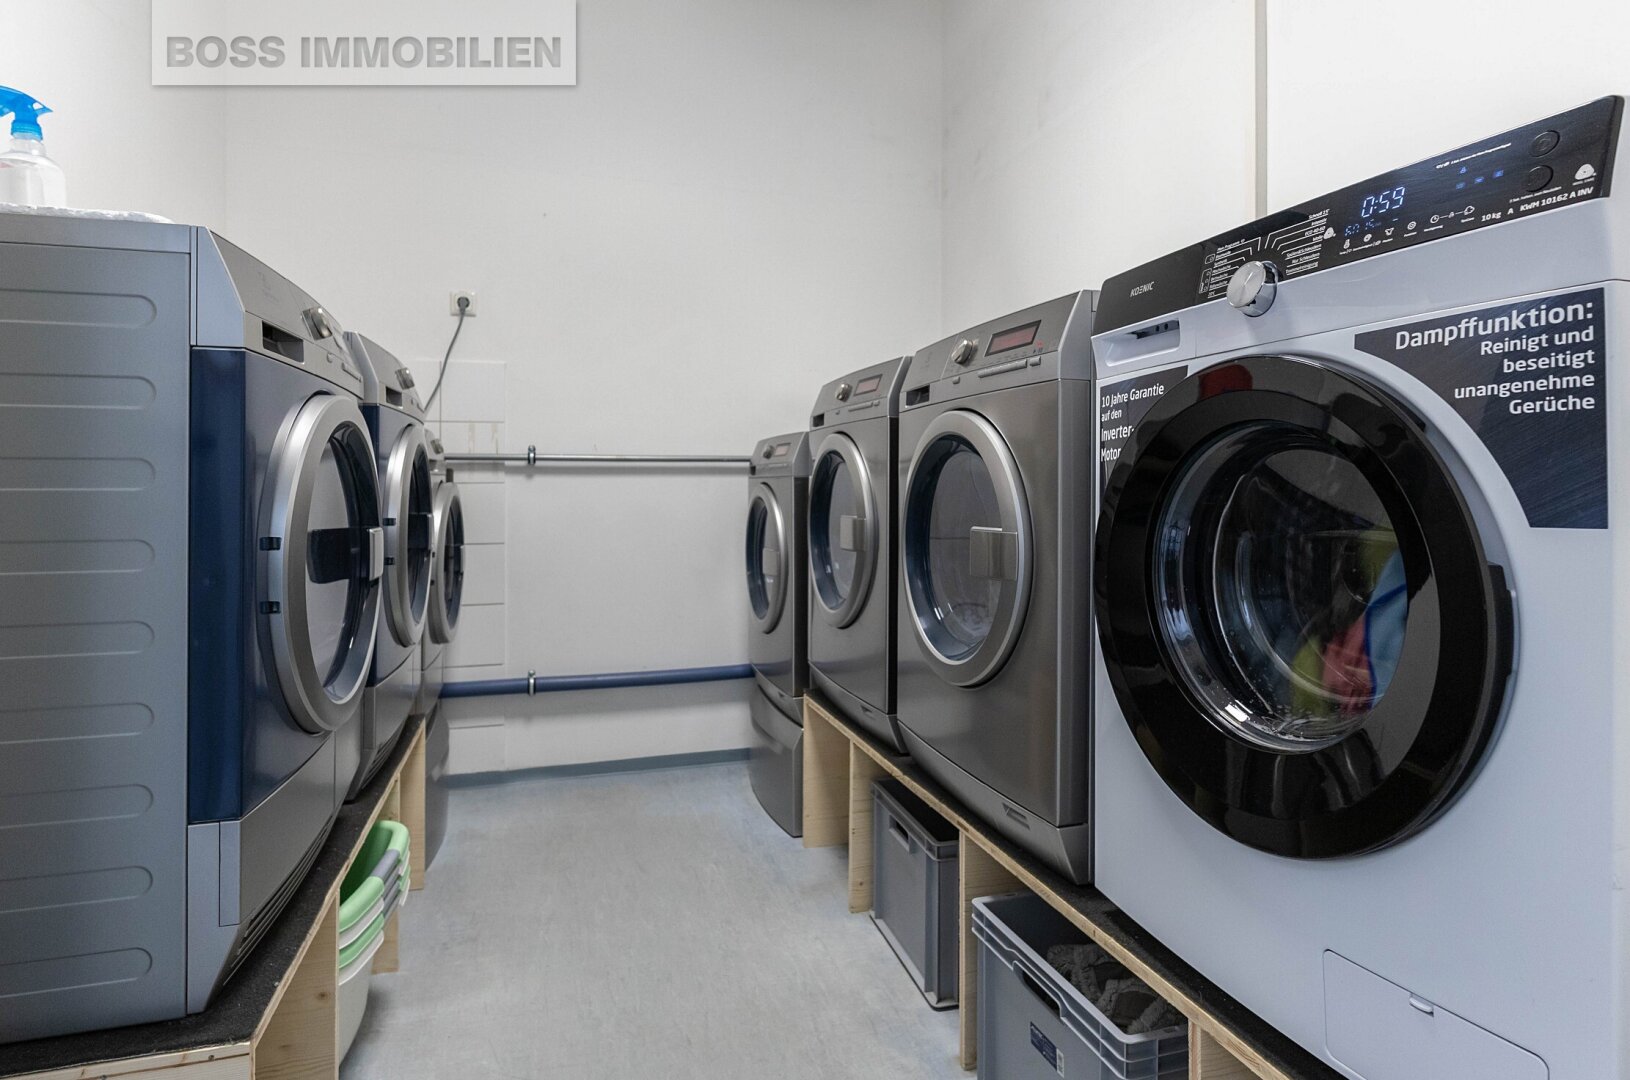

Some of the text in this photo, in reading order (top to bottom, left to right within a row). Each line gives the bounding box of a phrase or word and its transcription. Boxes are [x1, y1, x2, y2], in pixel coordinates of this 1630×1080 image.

[1361, 186, 1405, 218] 0:59
[1491, 212, 1501, 220] kg
[1507, 207, 1514, 215] A
[1520, 201, 1540, 211] KWM
[1541, 193, 1568, 207] 10162
[1569, 191, 1576, 199] A
[1577, 186, 1594, 197] INV
[1130, 281, 1154, 297] KOENIC
[1395, 302, 1593, 350] Dampffunktion:
[1480, 325, 1594, 356] Reinigt und
[1503, 349, 1595, 373] beseitigt
[1101, 383, 1165, 408] 10 Jahre Garantie
[1454, 374, 1595, 399] unangenehme
[1101, 409, 1122, 422] auf den
[1509, 394, 1595, 414] Gerüche
[1101, 425, 1135, 442] Inverter-
[1100, 447, 1122, 462] Motor
